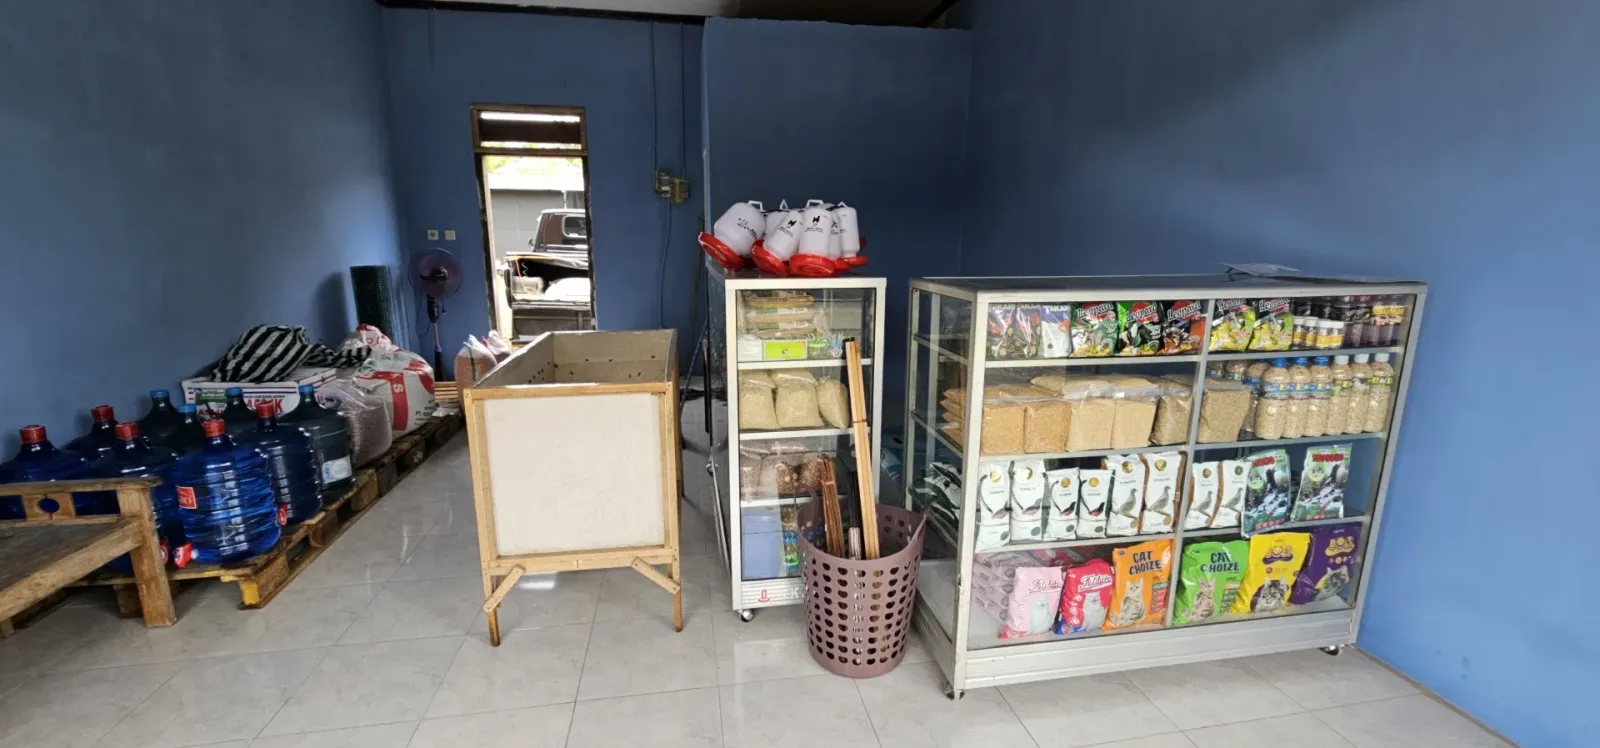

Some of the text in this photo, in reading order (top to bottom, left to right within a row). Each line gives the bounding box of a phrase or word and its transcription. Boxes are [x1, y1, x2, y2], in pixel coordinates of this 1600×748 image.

[1167, 300, 1201, 321] Leopard
[1133, 551, 1153, 564] CAT
[1129, 560, 1161, 575] CHOIZE
[1201, 562, 1239, 573] CHOIZE
